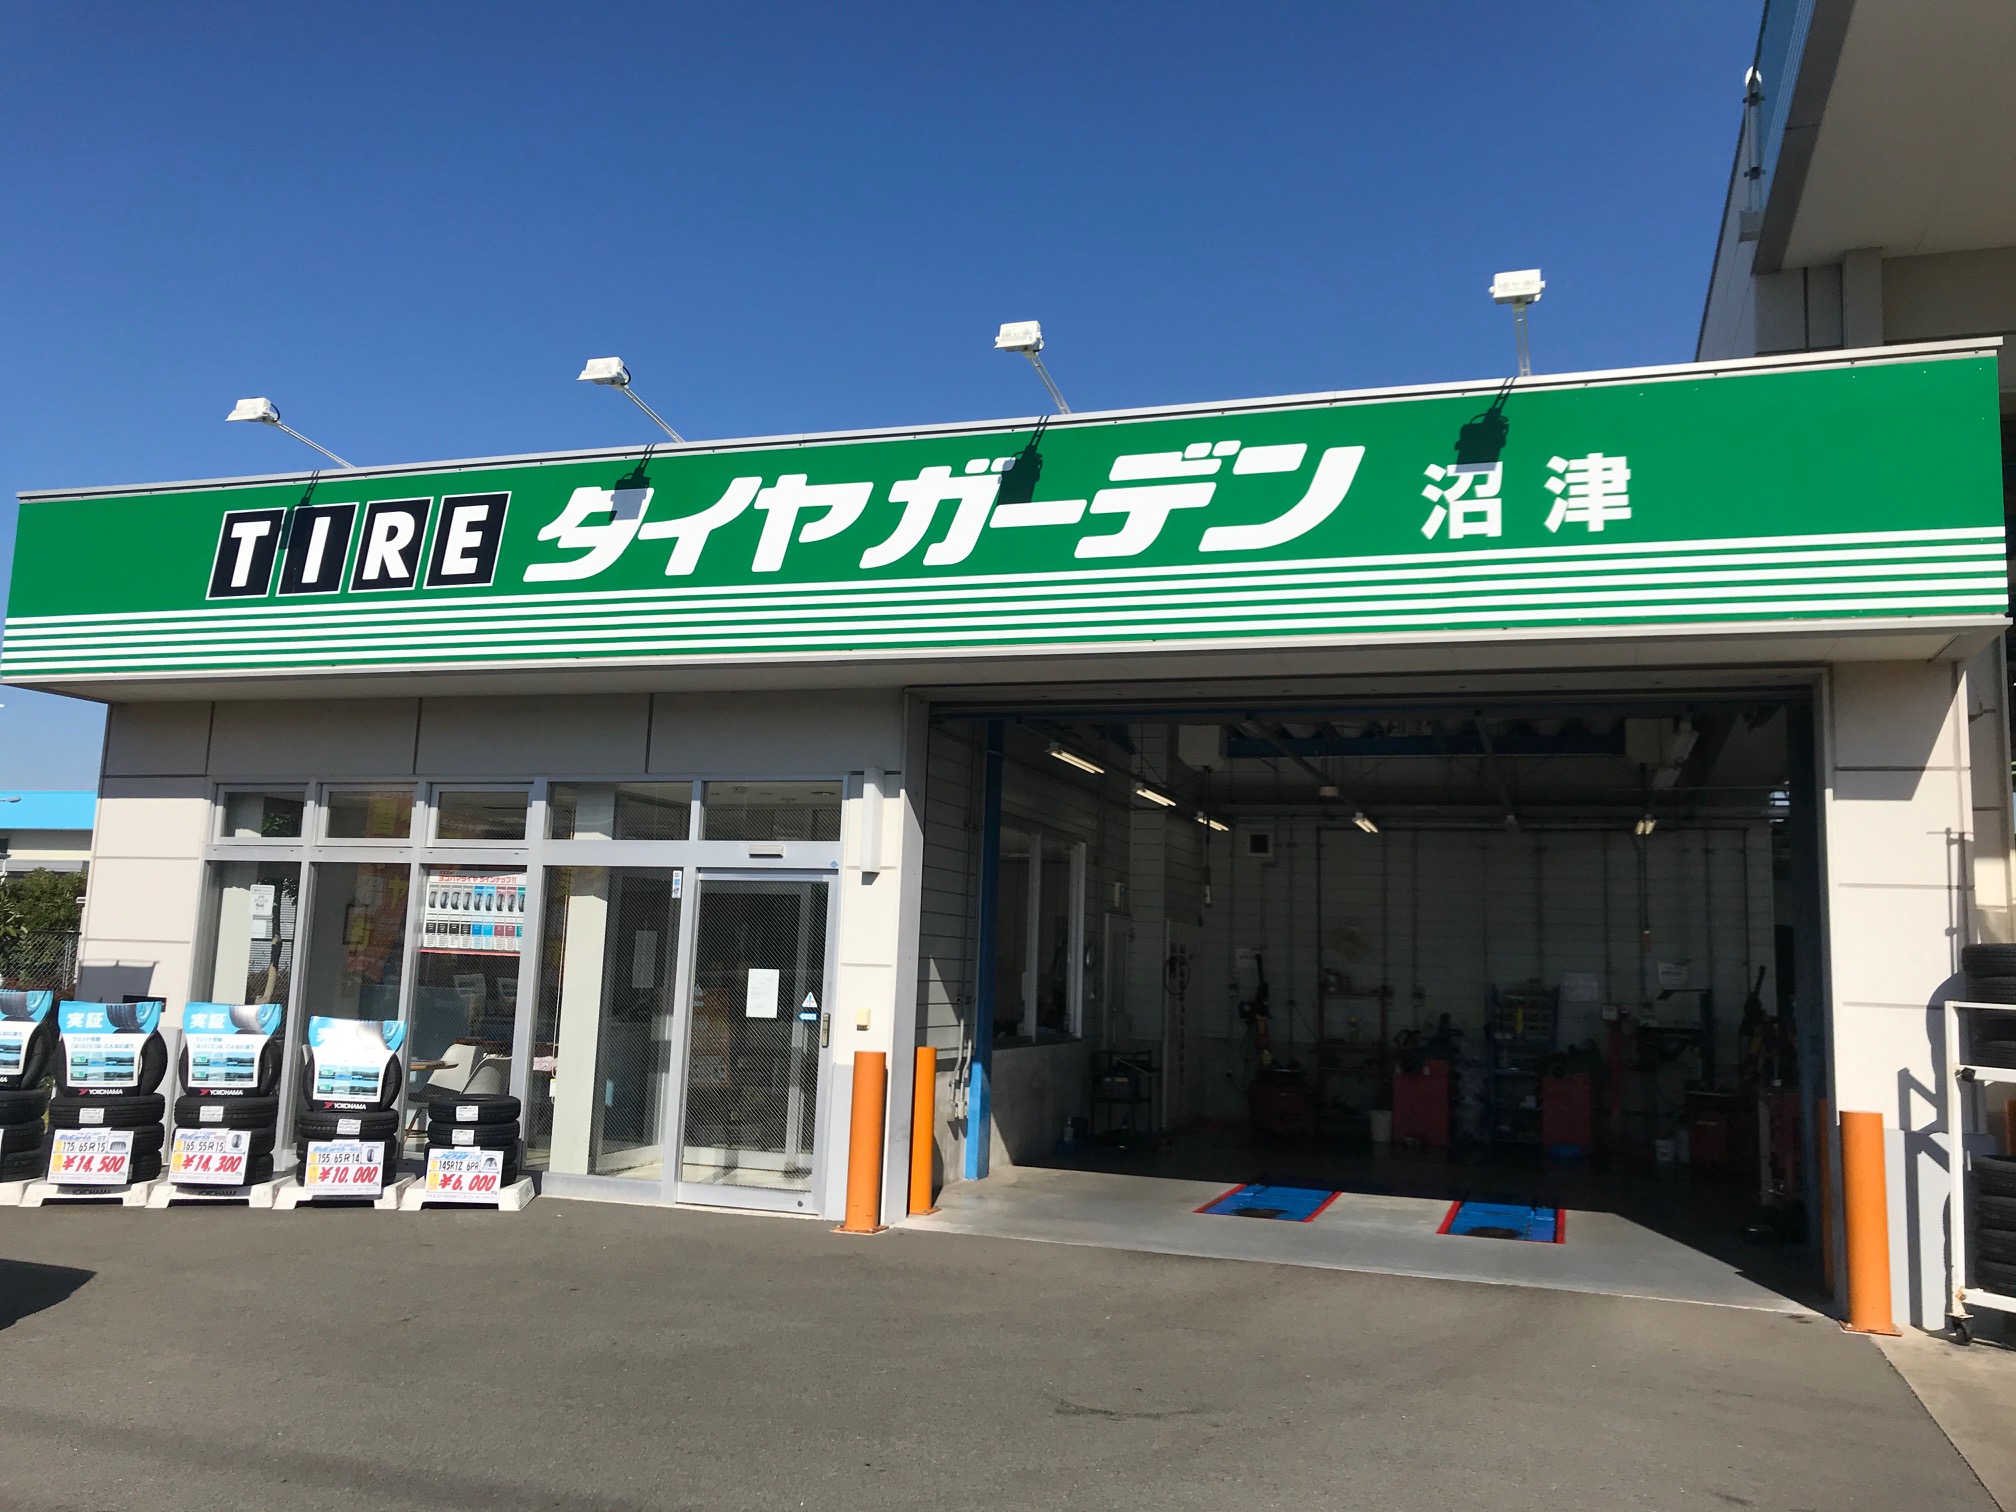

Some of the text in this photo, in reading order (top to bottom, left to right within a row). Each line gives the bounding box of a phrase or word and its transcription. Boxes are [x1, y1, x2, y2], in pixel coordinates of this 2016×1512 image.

[523, 440, 1633, 583] タイヤガーデン 沼津
[228, 504, 487, 589] TIRE
[66, 1012, 105, 1029] 実証
[189, 1013, 227, 1029] 実証
[209, 1088, 243, 1096] YOKOHAMA
[333, 1102, 367, 1110] YOKOHAMA
[466, 1161, 480, 1171] 6PR
